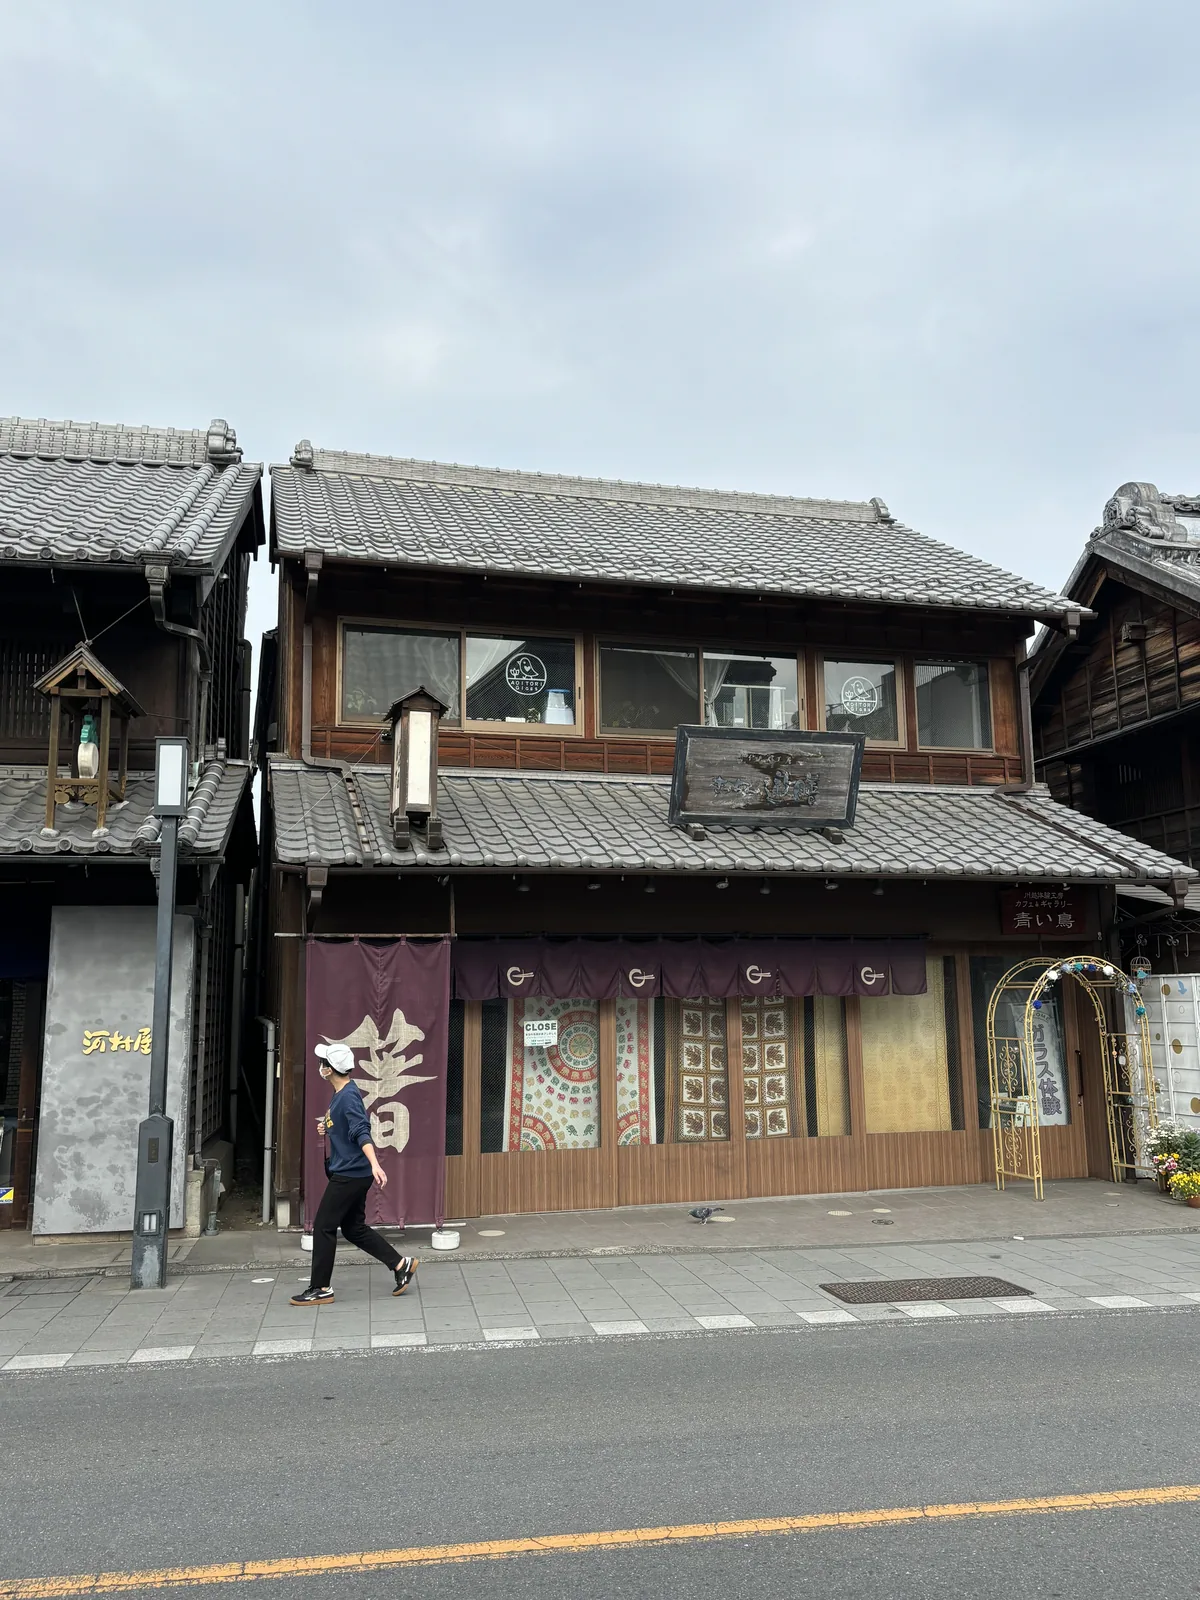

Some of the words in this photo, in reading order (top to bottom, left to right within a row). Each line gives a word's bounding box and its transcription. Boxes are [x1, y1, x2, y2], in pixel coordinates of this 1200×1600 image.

[1013, 911, 1076, 929] 青い鳥
[525, 1022, 557, 1032] CLOSE
[82, 1027, 153, 1055] 河村屋
[1032, 1023, 1062, 1116] ガラス体験
